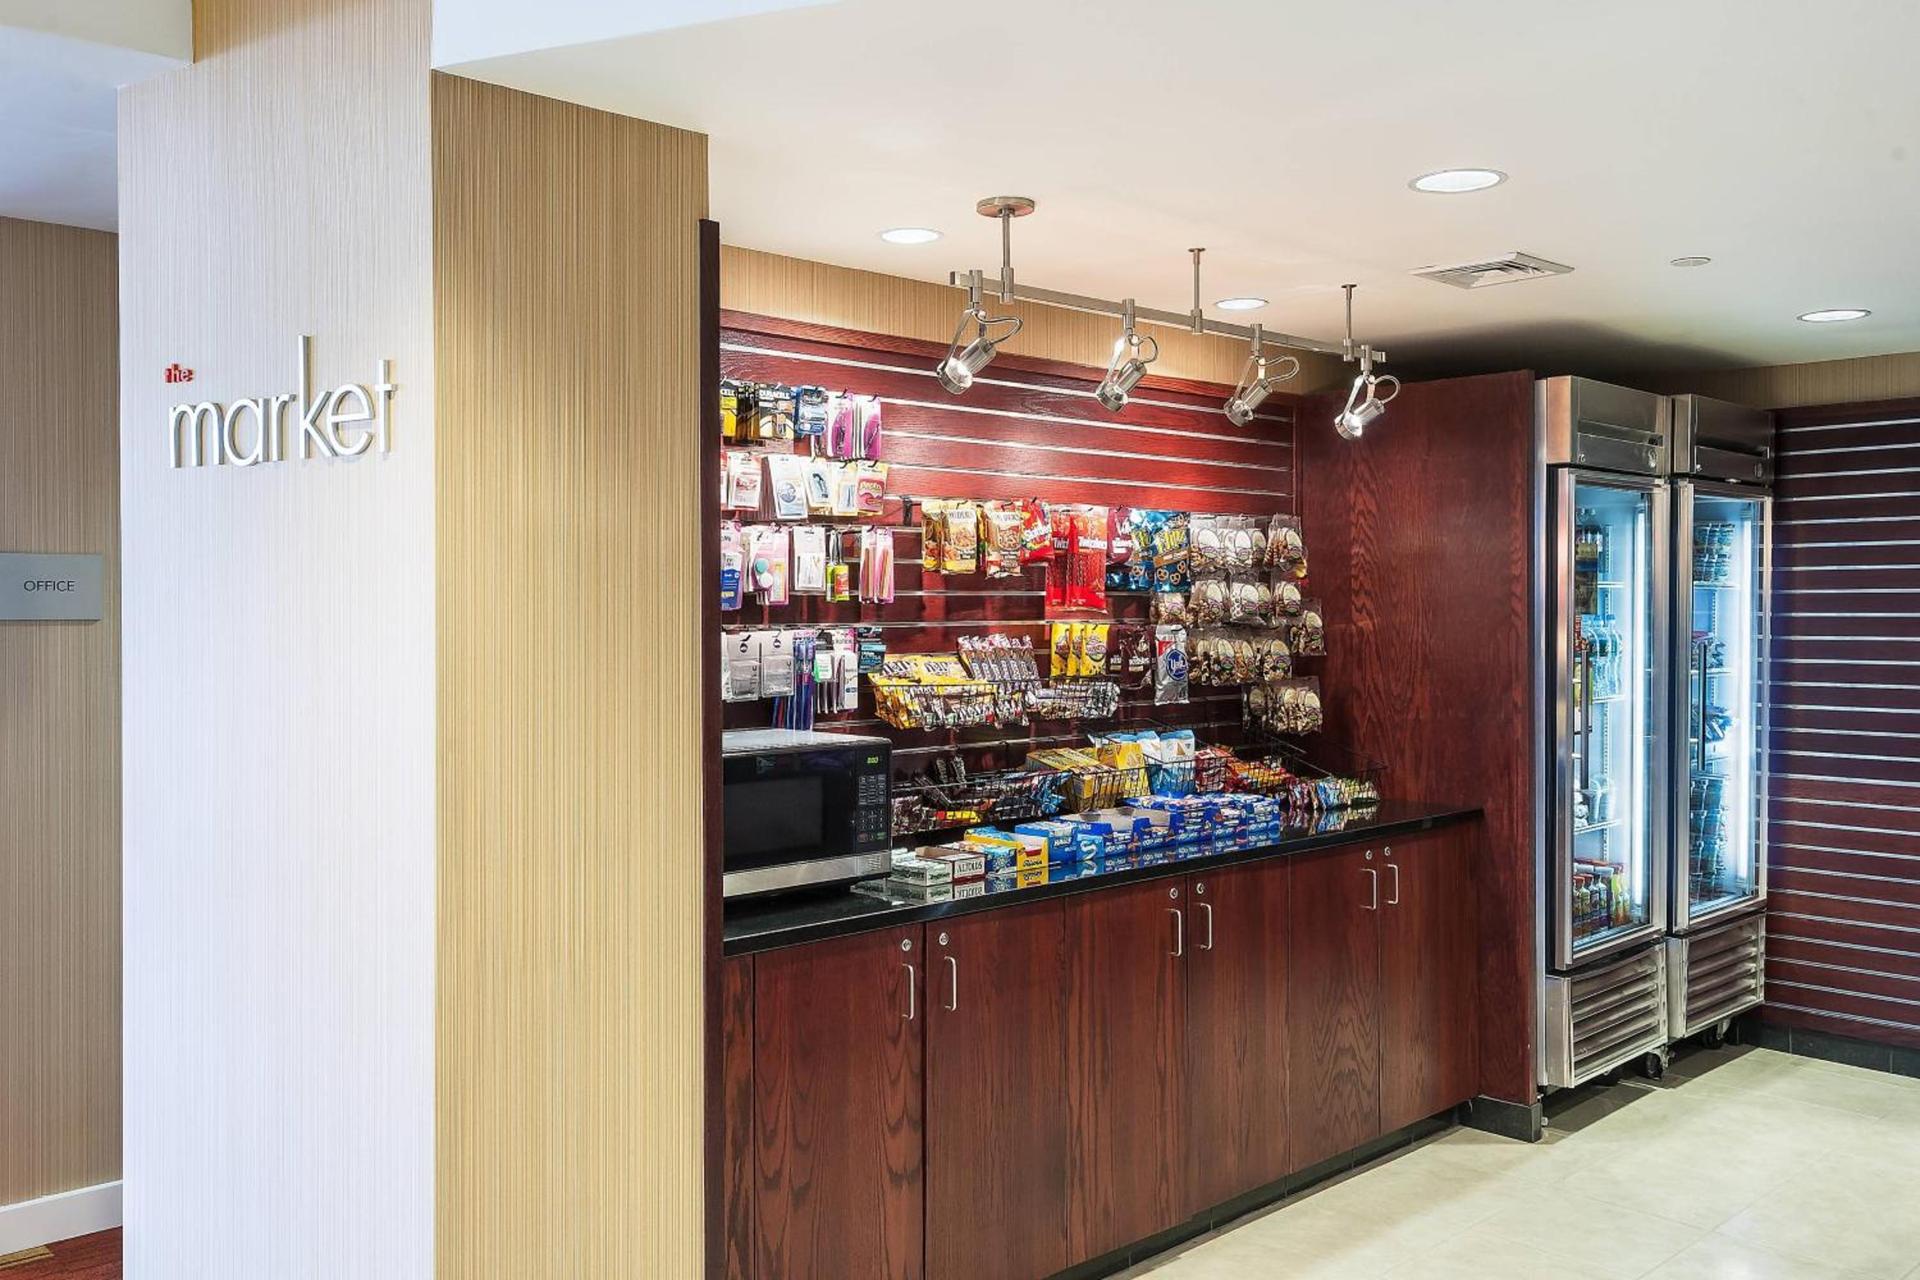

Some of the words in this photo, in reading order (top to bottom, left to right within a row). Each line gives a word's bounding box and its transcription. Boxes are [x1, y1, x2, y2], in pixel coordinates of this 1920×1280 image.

[164, 362, 193, 383] the
[168, 334, 398, 469] market
[23, 580, 76, 592] OFFICE
